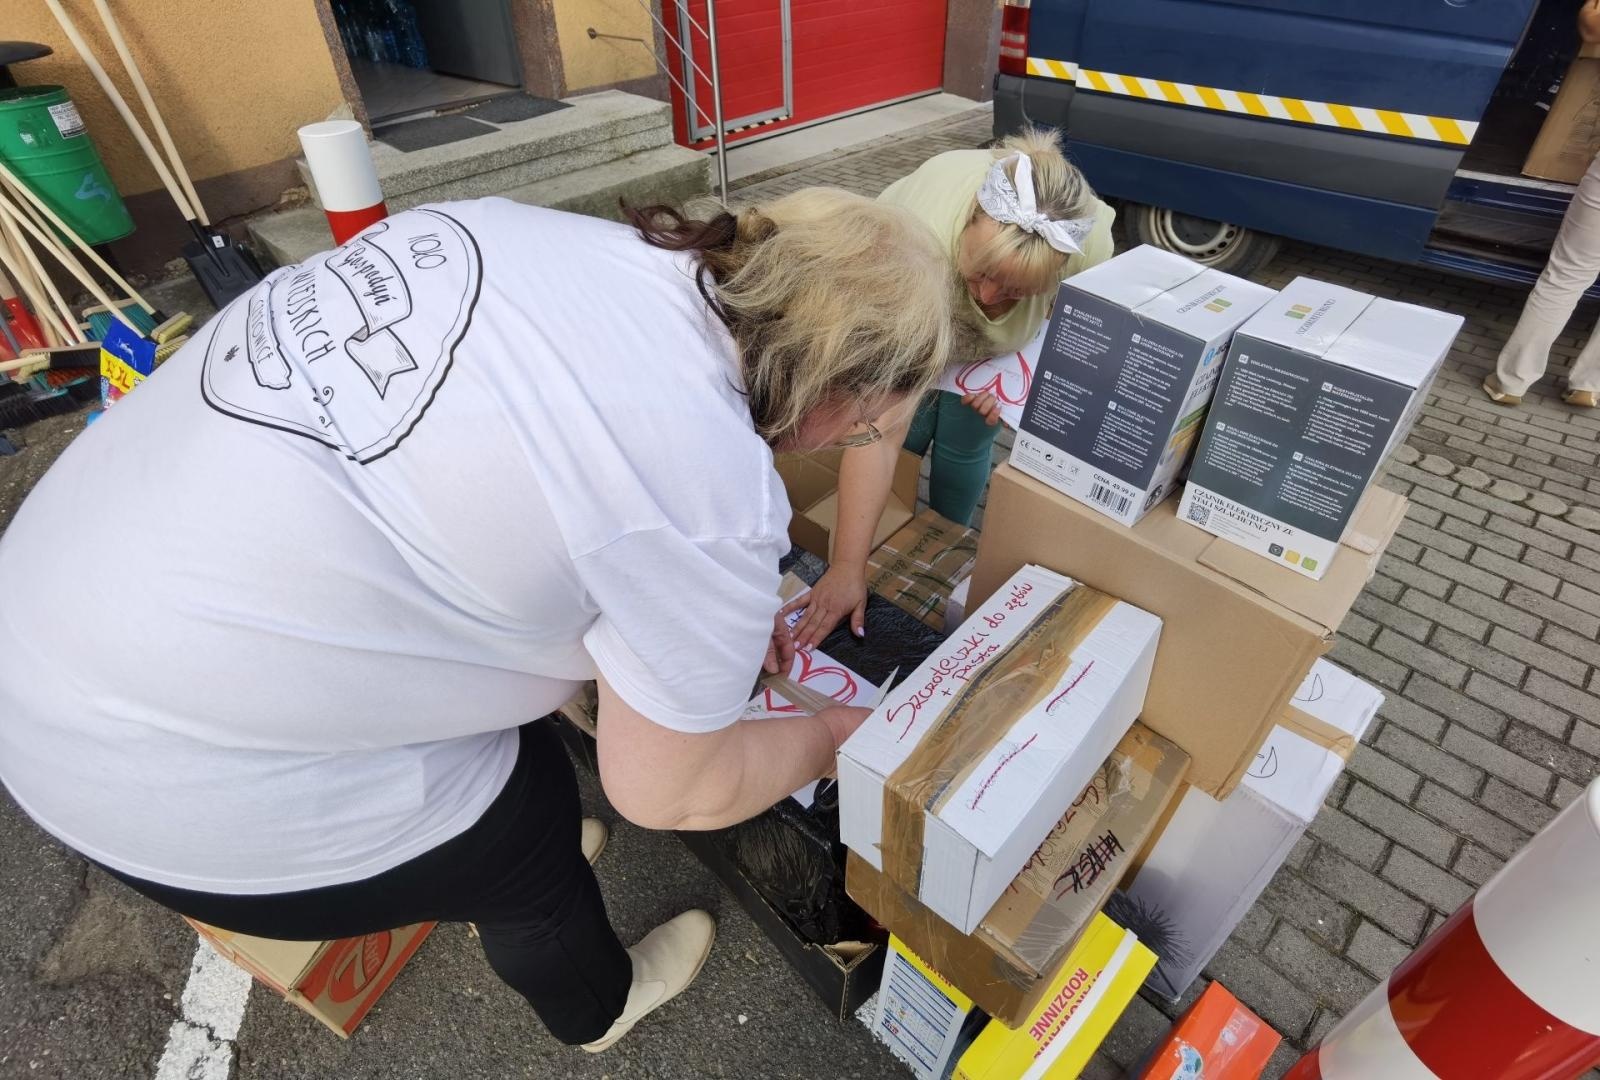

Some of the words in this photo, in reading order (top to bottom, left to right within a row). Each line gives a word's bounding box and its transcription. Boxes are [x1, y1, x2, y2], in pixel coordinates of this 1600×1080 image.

[1192, 495, 1214, 509] STALI
[1214, 506, 1269, 533] SZLACHETNEJ
[1194, 488, 1226, 507] CZAJNIK
[1226, 503, 1282, 531] ELEKTRYCZNY
[983, 612, 1006, 629] do
[1029, 967, 1089, 1041] RODZINNE
